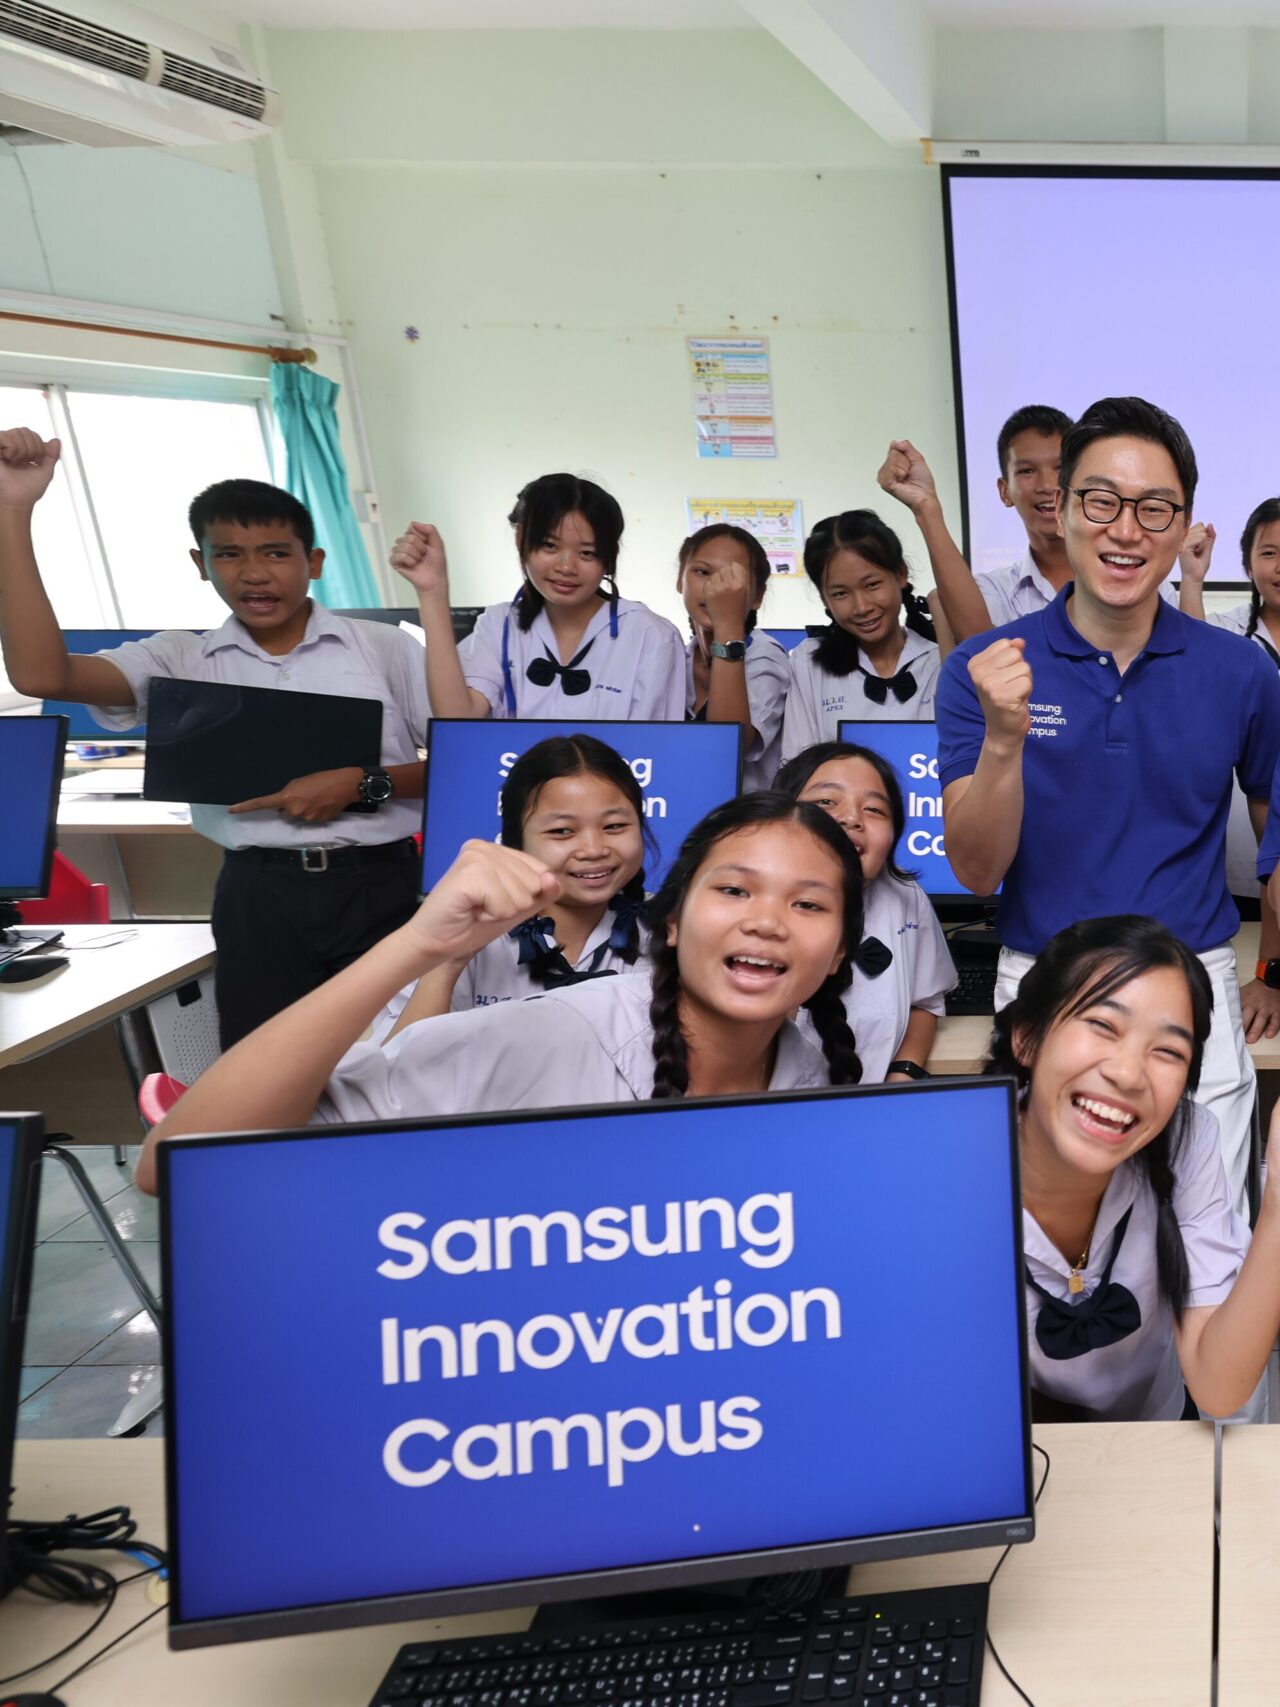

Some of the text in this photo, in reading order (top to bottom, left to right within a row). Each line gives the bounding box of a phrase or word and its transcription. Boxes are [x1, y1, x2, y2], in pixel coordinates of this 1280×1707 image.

[1028, 703, 1062, 715] msung
[1028, 727, 1057, 738] mpus
[1030, 715, 1067, 726] ovation
[377, 1191, 795, 1280] Samsung
[381, 1278, 842, 1385] Innovation
[383, 1395, 763, 1487] Campus
